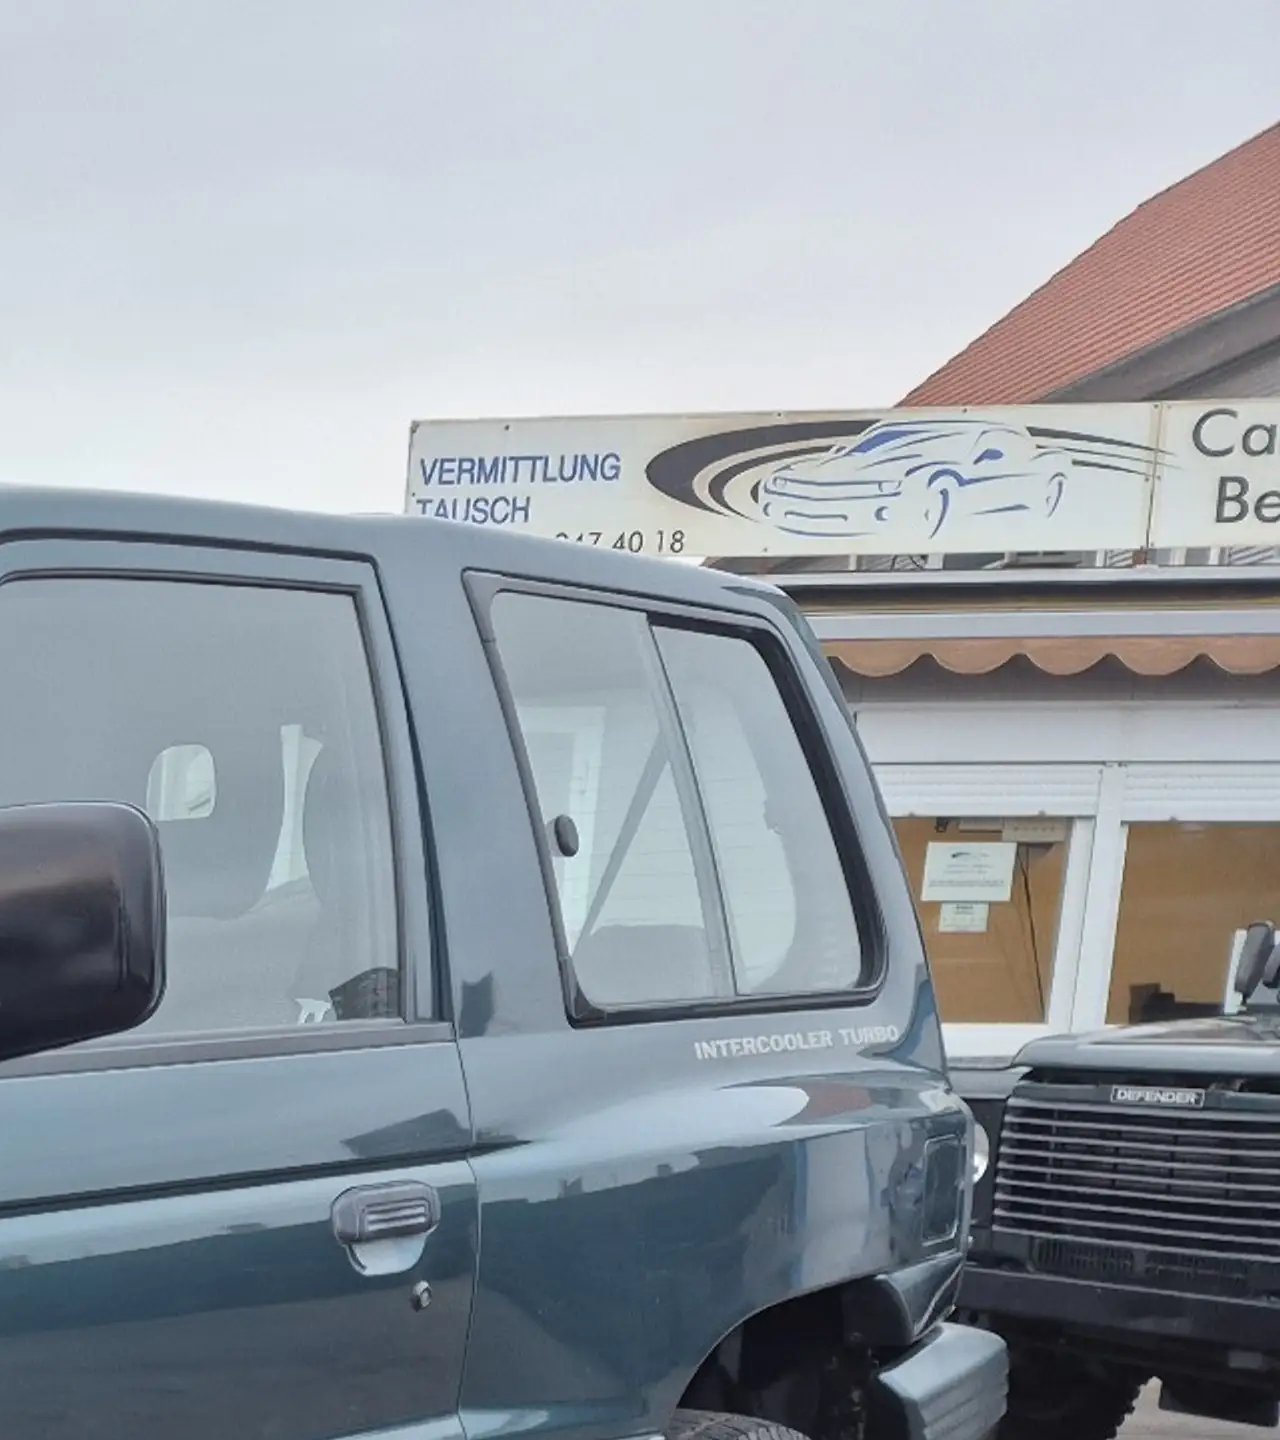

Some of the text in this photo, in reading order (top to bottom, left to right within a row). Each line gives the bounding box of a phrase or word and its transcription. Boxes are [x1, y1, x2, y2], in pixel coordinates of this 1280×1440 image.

[1192, 407, 1280, 458] Ca
[419, 453, 622, 486] VERMITTLUNG
[416, 496, 531, 525] TAUSCH
[611, 531, 644, 553] 40
[656, 530, 685, 553] 18
[693, 1024, 899, 1061] INTERCOOLER TURBO
[1117, 1089, 1196, 1105] DEFENDER
